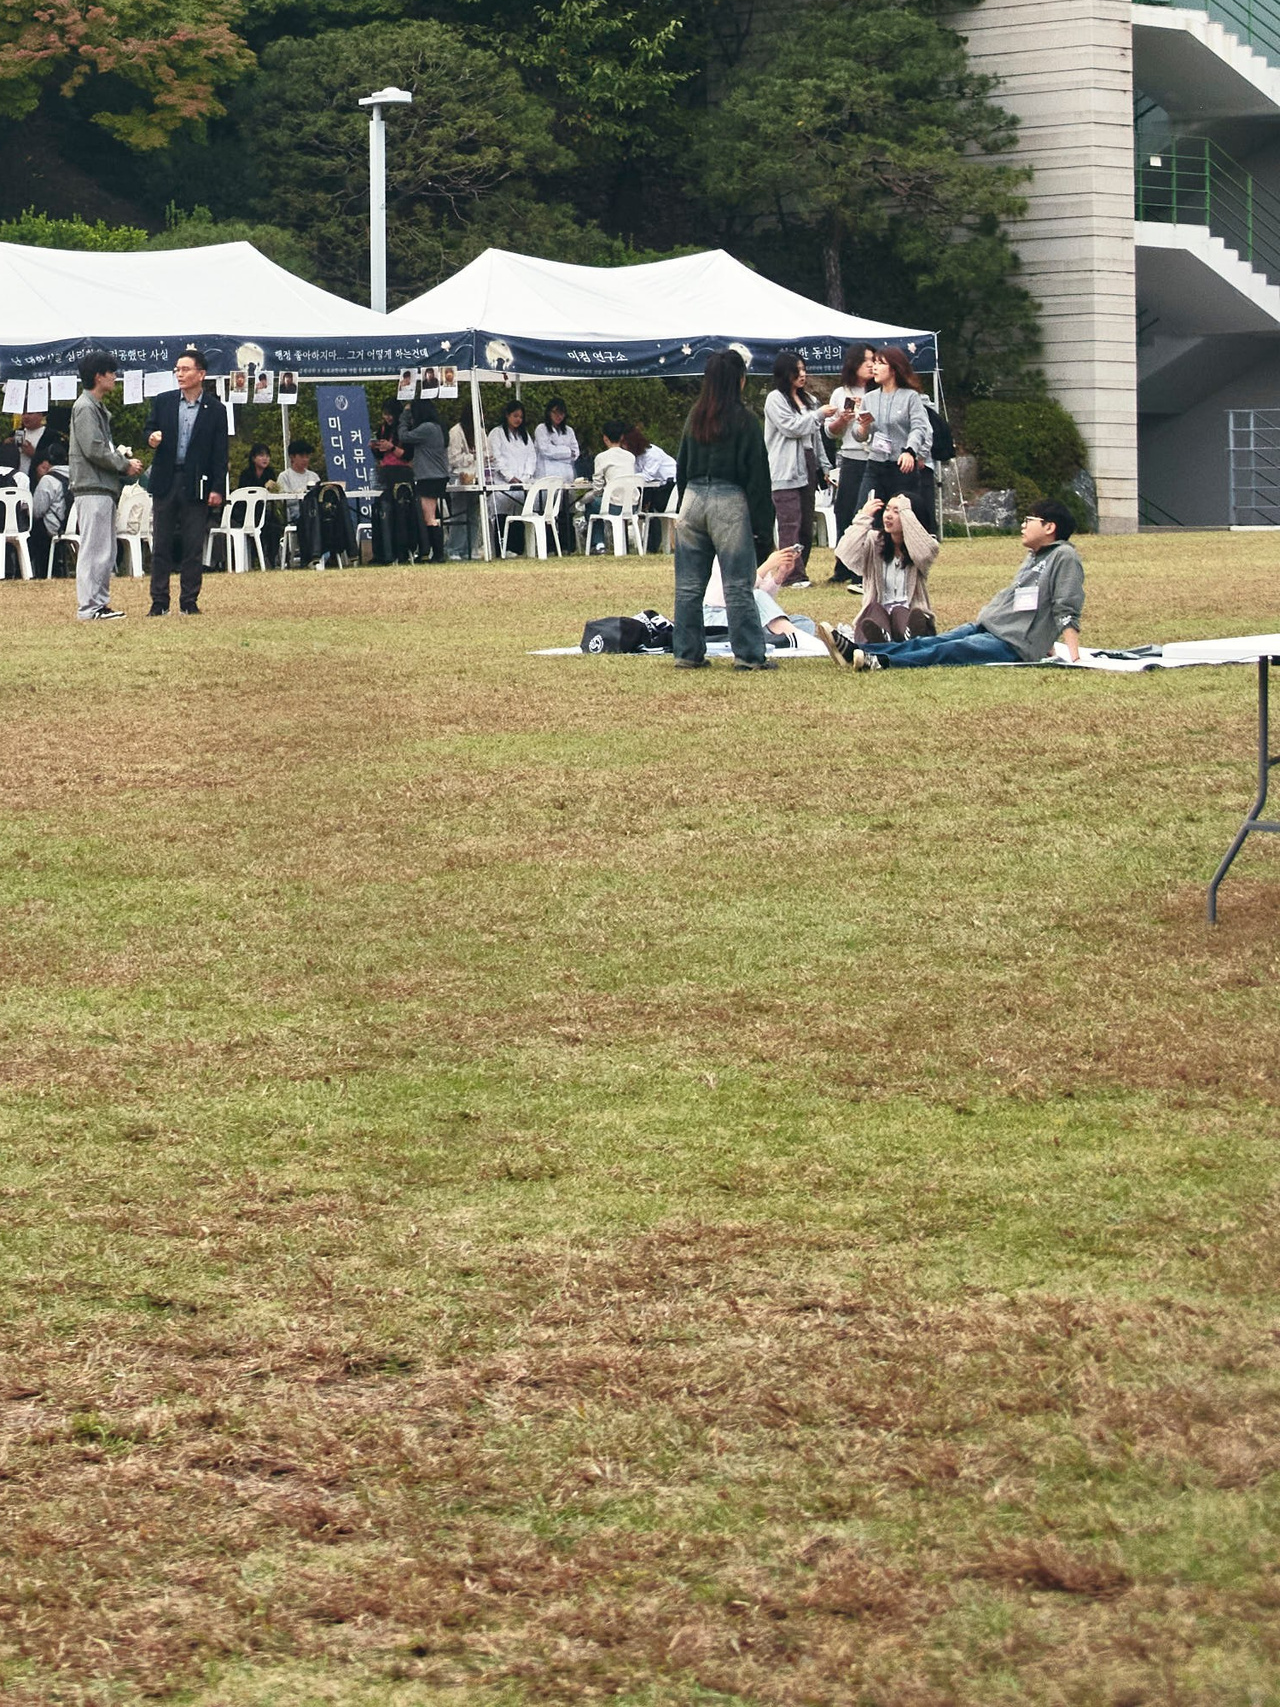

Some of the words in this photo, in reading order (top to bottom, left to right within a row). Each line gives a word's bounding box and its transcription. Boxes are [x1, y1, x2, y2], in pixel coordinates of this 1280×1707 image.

[149, 348, 169, 361] 사실
[346, 349, 364, 361] 그거
[366, 348, 392, 361] 어떻게
[395, 347, 429, 359] 하는건데
[567, 349, 591, 363] 미컴
[592, 350, 629, 363] 연구소
[812, 345, 842, 360] 동심의
[328, 416, 347, 470] 미디어
